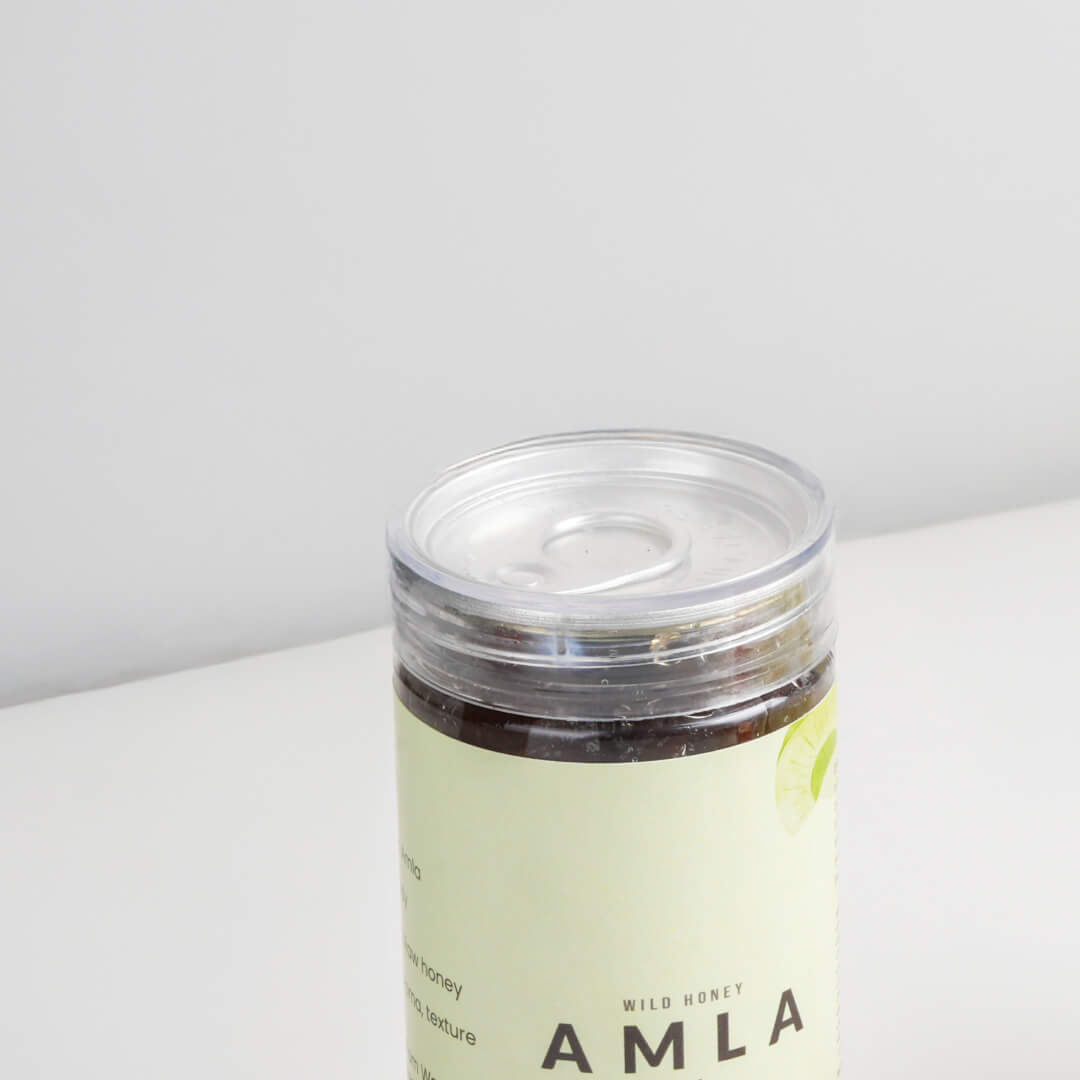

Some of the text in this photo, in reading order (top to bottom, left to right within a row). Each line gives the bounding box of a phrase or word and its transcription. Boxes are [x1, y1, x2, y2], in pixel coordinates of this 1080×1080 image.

[421, 956, 463, 1001] honey
[623, 982, 743, 1012] WILD HONEY
[426, 1005, 477, 1046] texture
[541, 987, 804, 1074] AMLA
